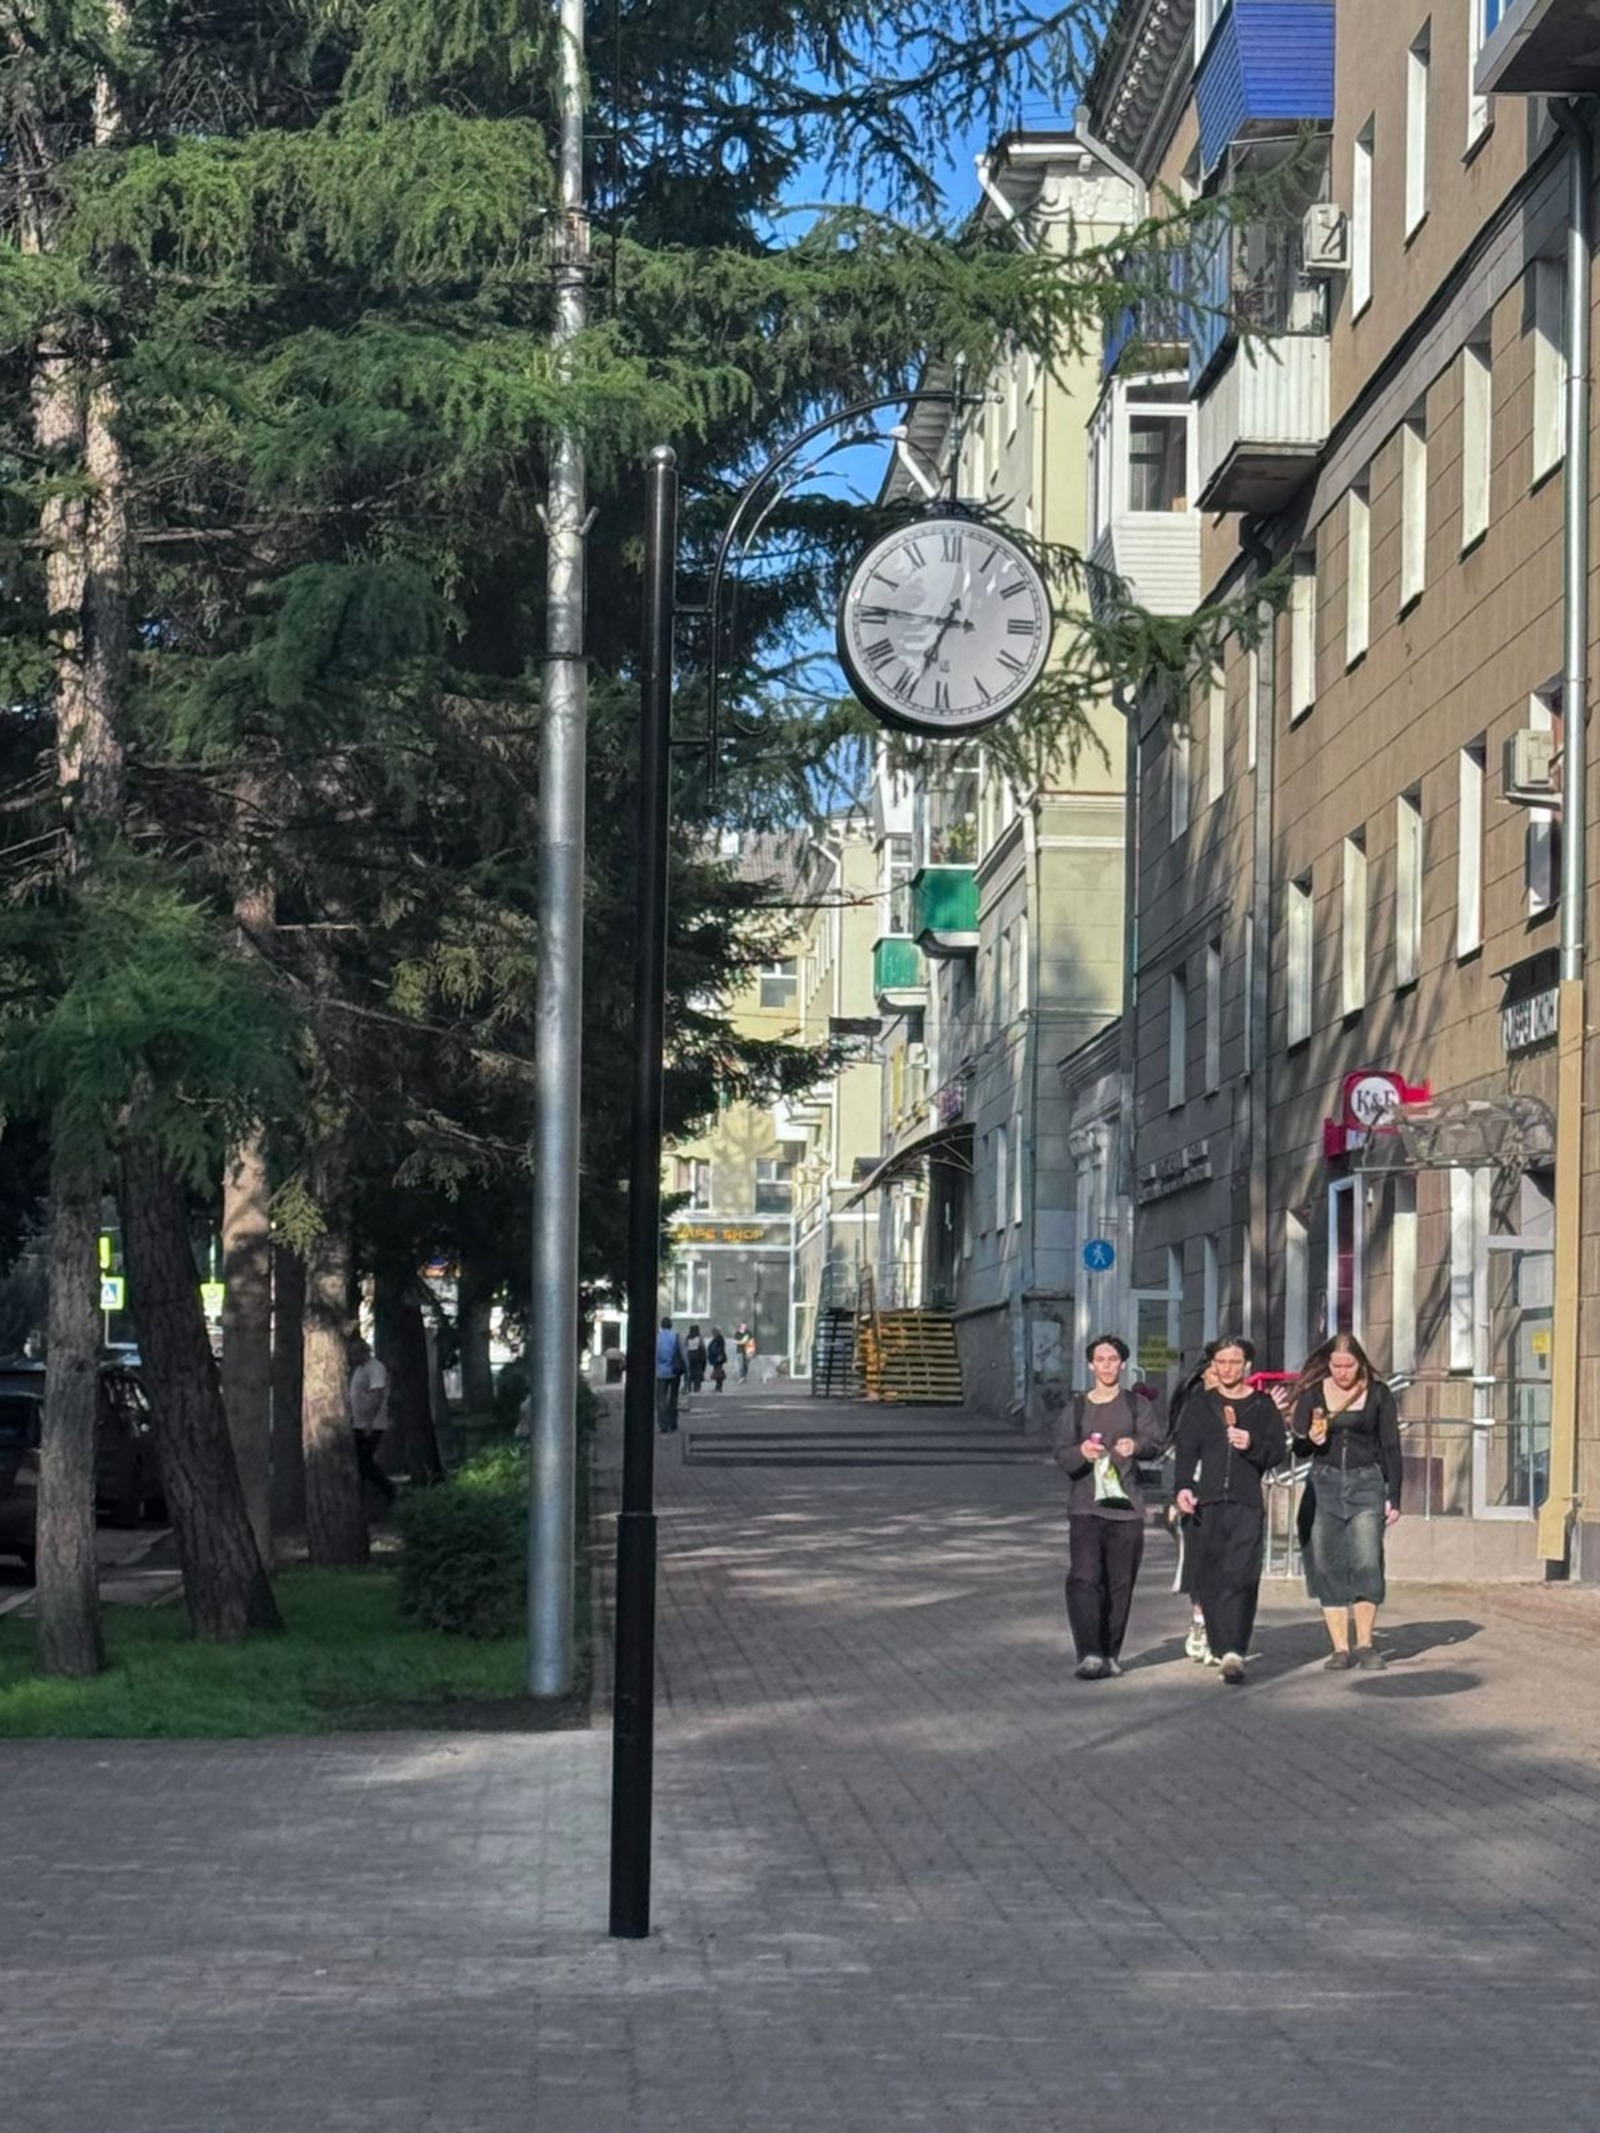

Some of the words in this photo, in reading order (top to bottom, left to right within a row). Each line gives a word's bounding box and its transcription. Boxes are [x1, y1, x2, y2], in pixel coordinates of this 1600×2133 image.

[902, 541, 926, 571] XI
[941, 536, 962, 563] XII
[980, 546, 999, 573] I
[872, 573, 899, 592] X
[1000, 580, 1027, 600] II
[1007, 619, 1035, 635] III
[865, 638, 897, 671] VIII
[997, 649, 1025, 676] IV
[893, 667, 920, 700] VII
[934, 680, 950, 709] VI
[973, 676, 991, 704] V
[722, 1226, 766, 1241] SHOP
